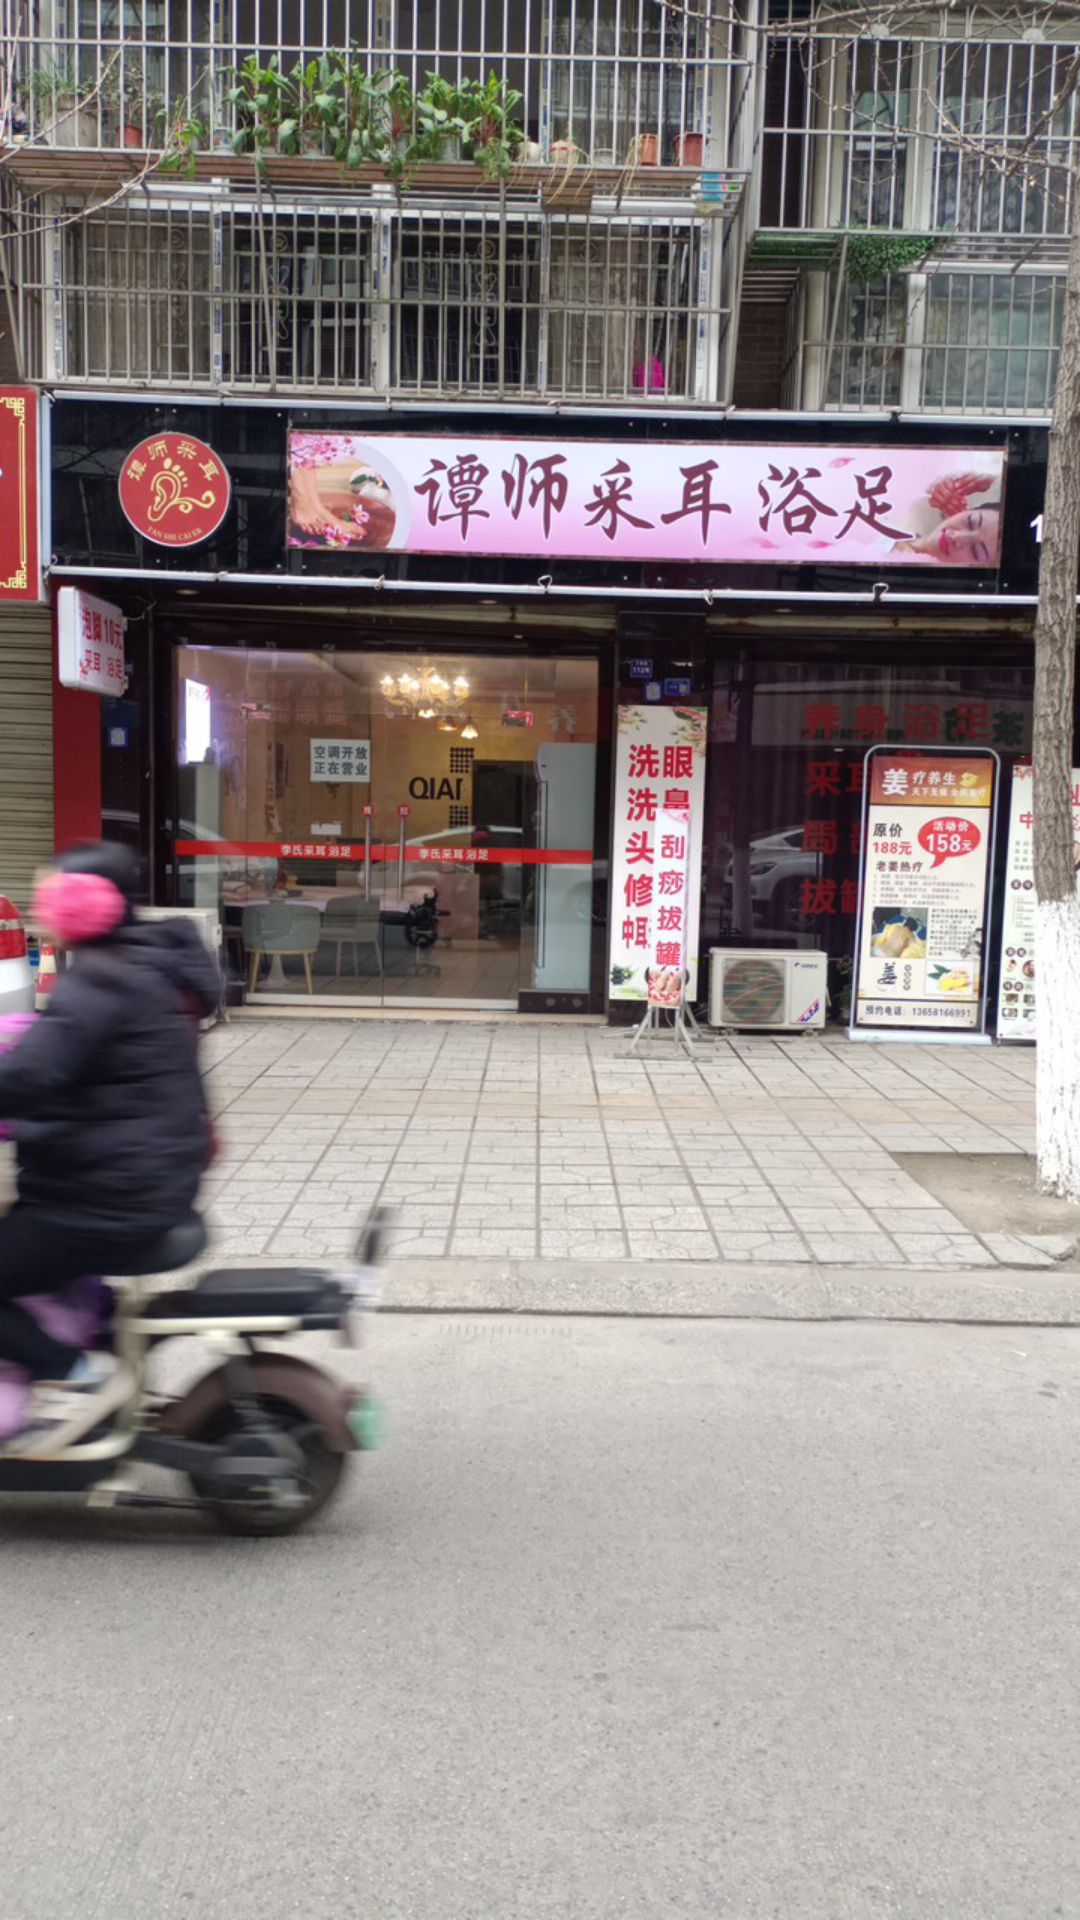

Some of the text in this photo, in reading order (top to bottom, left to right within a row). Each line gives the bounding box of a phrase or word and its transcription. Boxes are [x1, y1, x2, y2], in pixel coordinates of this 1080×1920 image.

[314, 745, 368, 760] 空调开放
[314, 761, 367, 776] 正在营业
[872, 823, 902, 838] 原价
[873, 841, 912, 856] 188元
